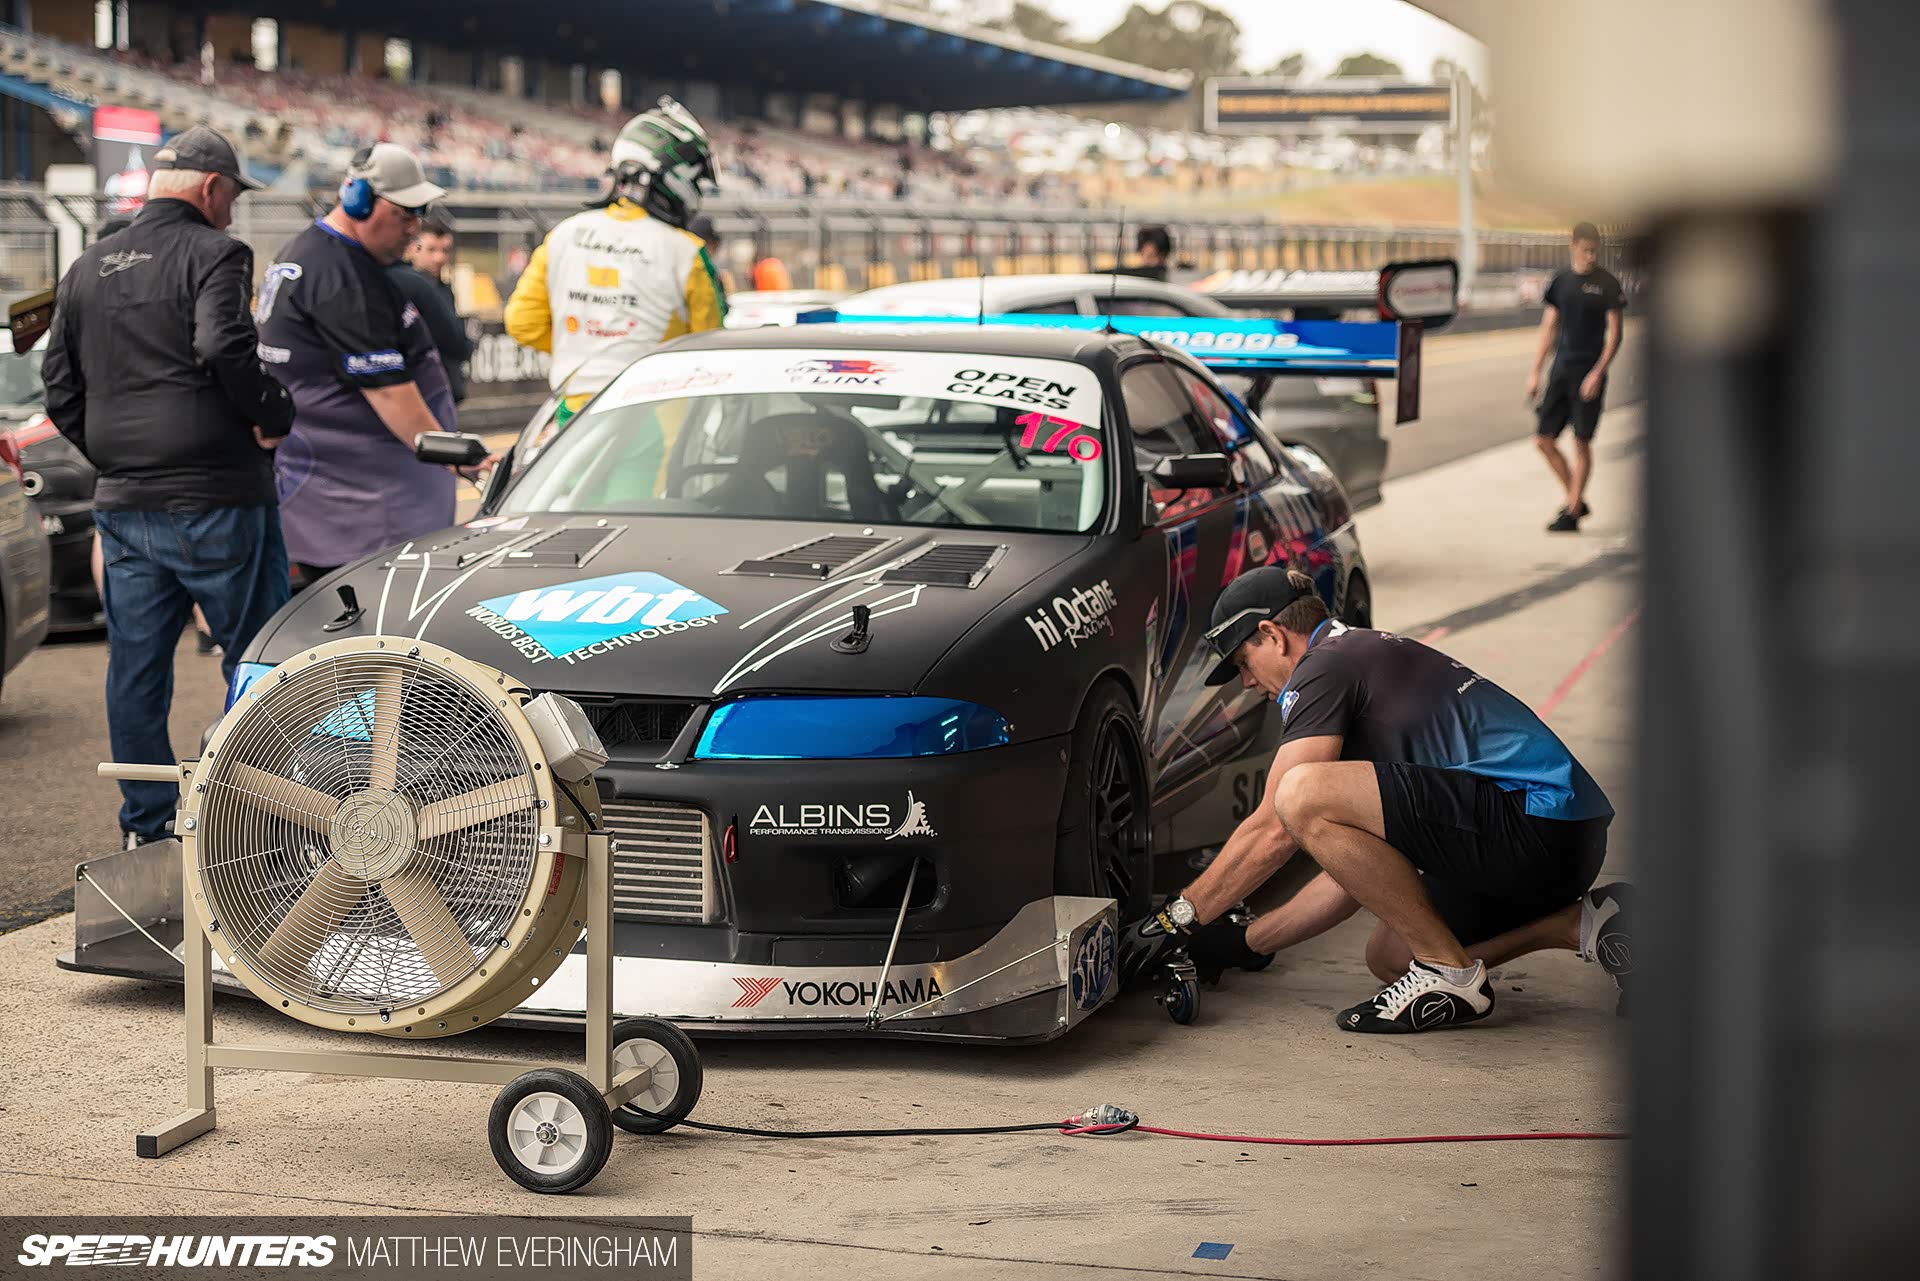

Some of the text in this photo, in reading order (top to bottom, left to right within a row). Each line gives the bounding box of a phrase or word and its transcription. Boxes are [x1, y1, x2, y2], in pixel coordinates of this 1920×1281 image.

[946, 382, 1071, 410] CLASS
[954, 369, 1078, 397] OPEN
[503, 585, 703, 627] wbt
[1024, 579, 1118, 652] hi Octane
[464, 604, 555, 664] WORLDS BEST
[557, 614, 719, 665] TECHNOLOGY
[749, 804, 891, 827] ALBINS
[749, 827, 893, 836] PERFORMANCE TRANSMISSIONS
[782, 977, 945, 1006] YOKOHAMA
